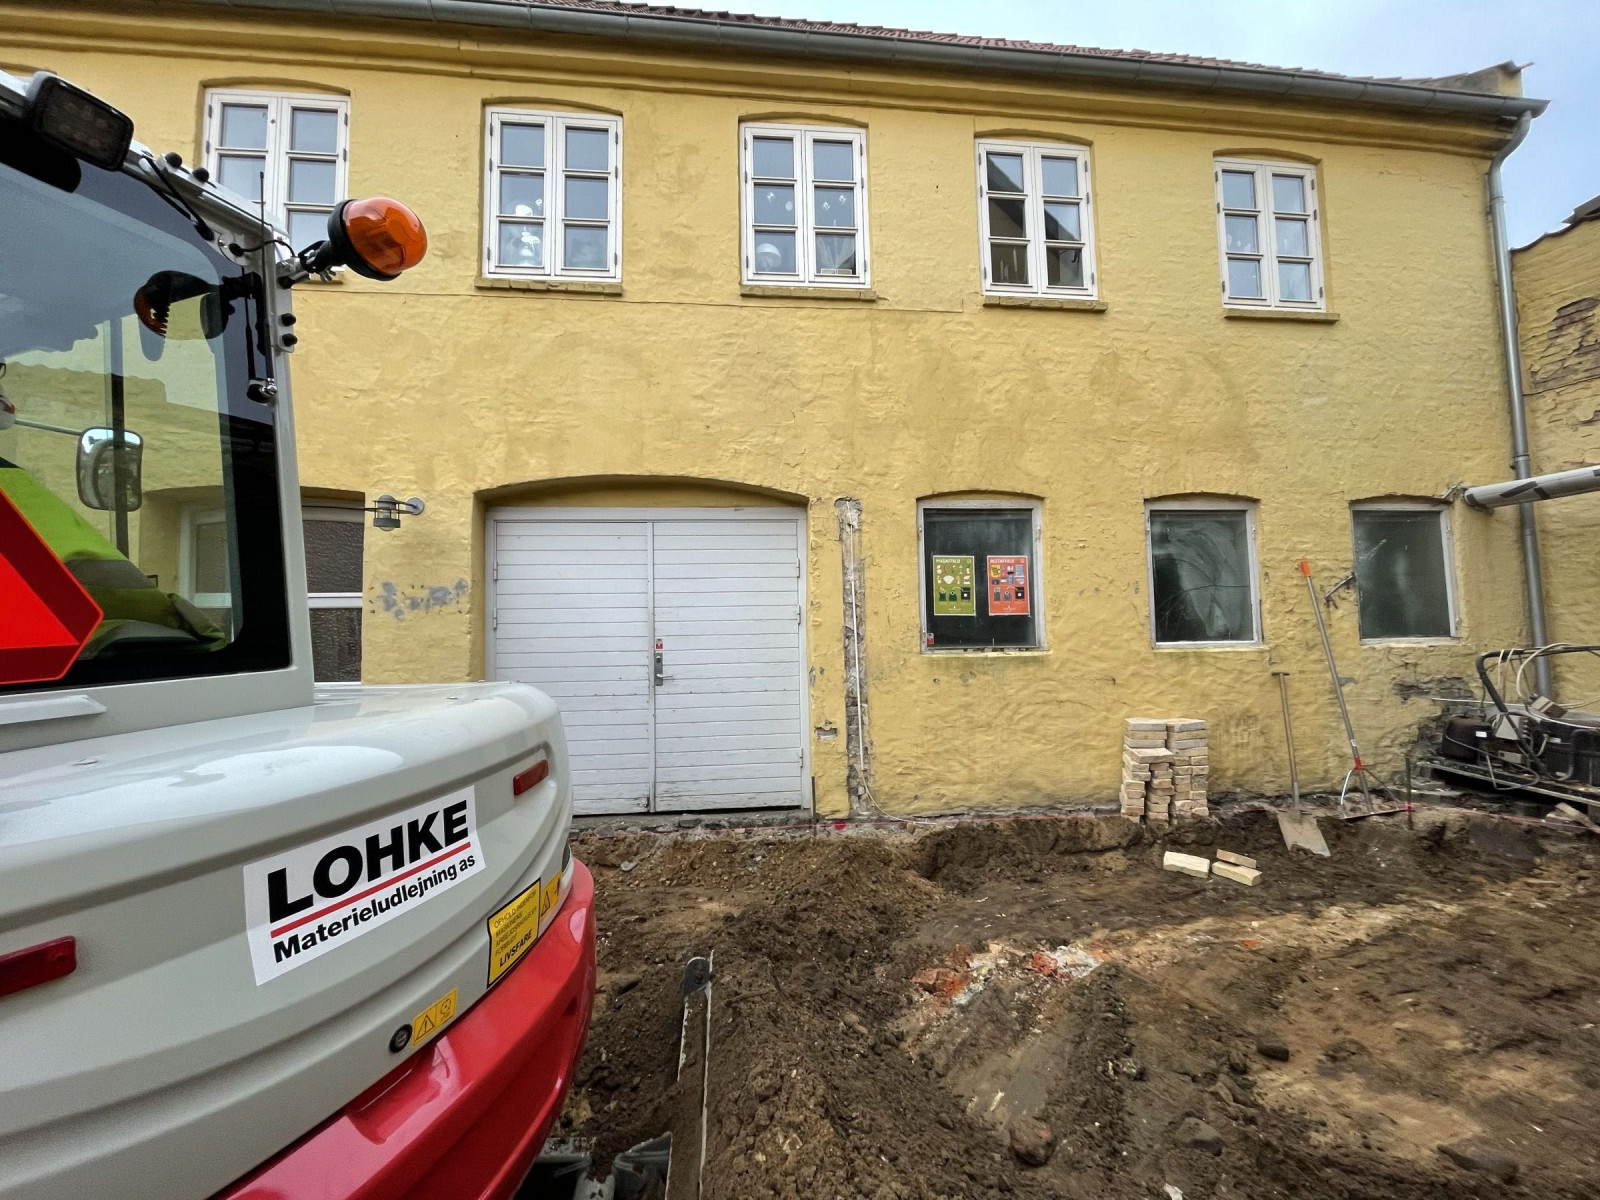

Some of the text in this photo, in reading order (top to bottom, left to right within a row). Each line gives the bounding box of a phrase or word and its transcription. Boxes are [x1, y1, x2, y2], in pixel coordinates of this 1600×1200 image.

[267, 800, 469, 924] LOHKE
[273, 855, 475, 963] Materieludlejning as
[500, 928, 533, 968] LIVSFARE
